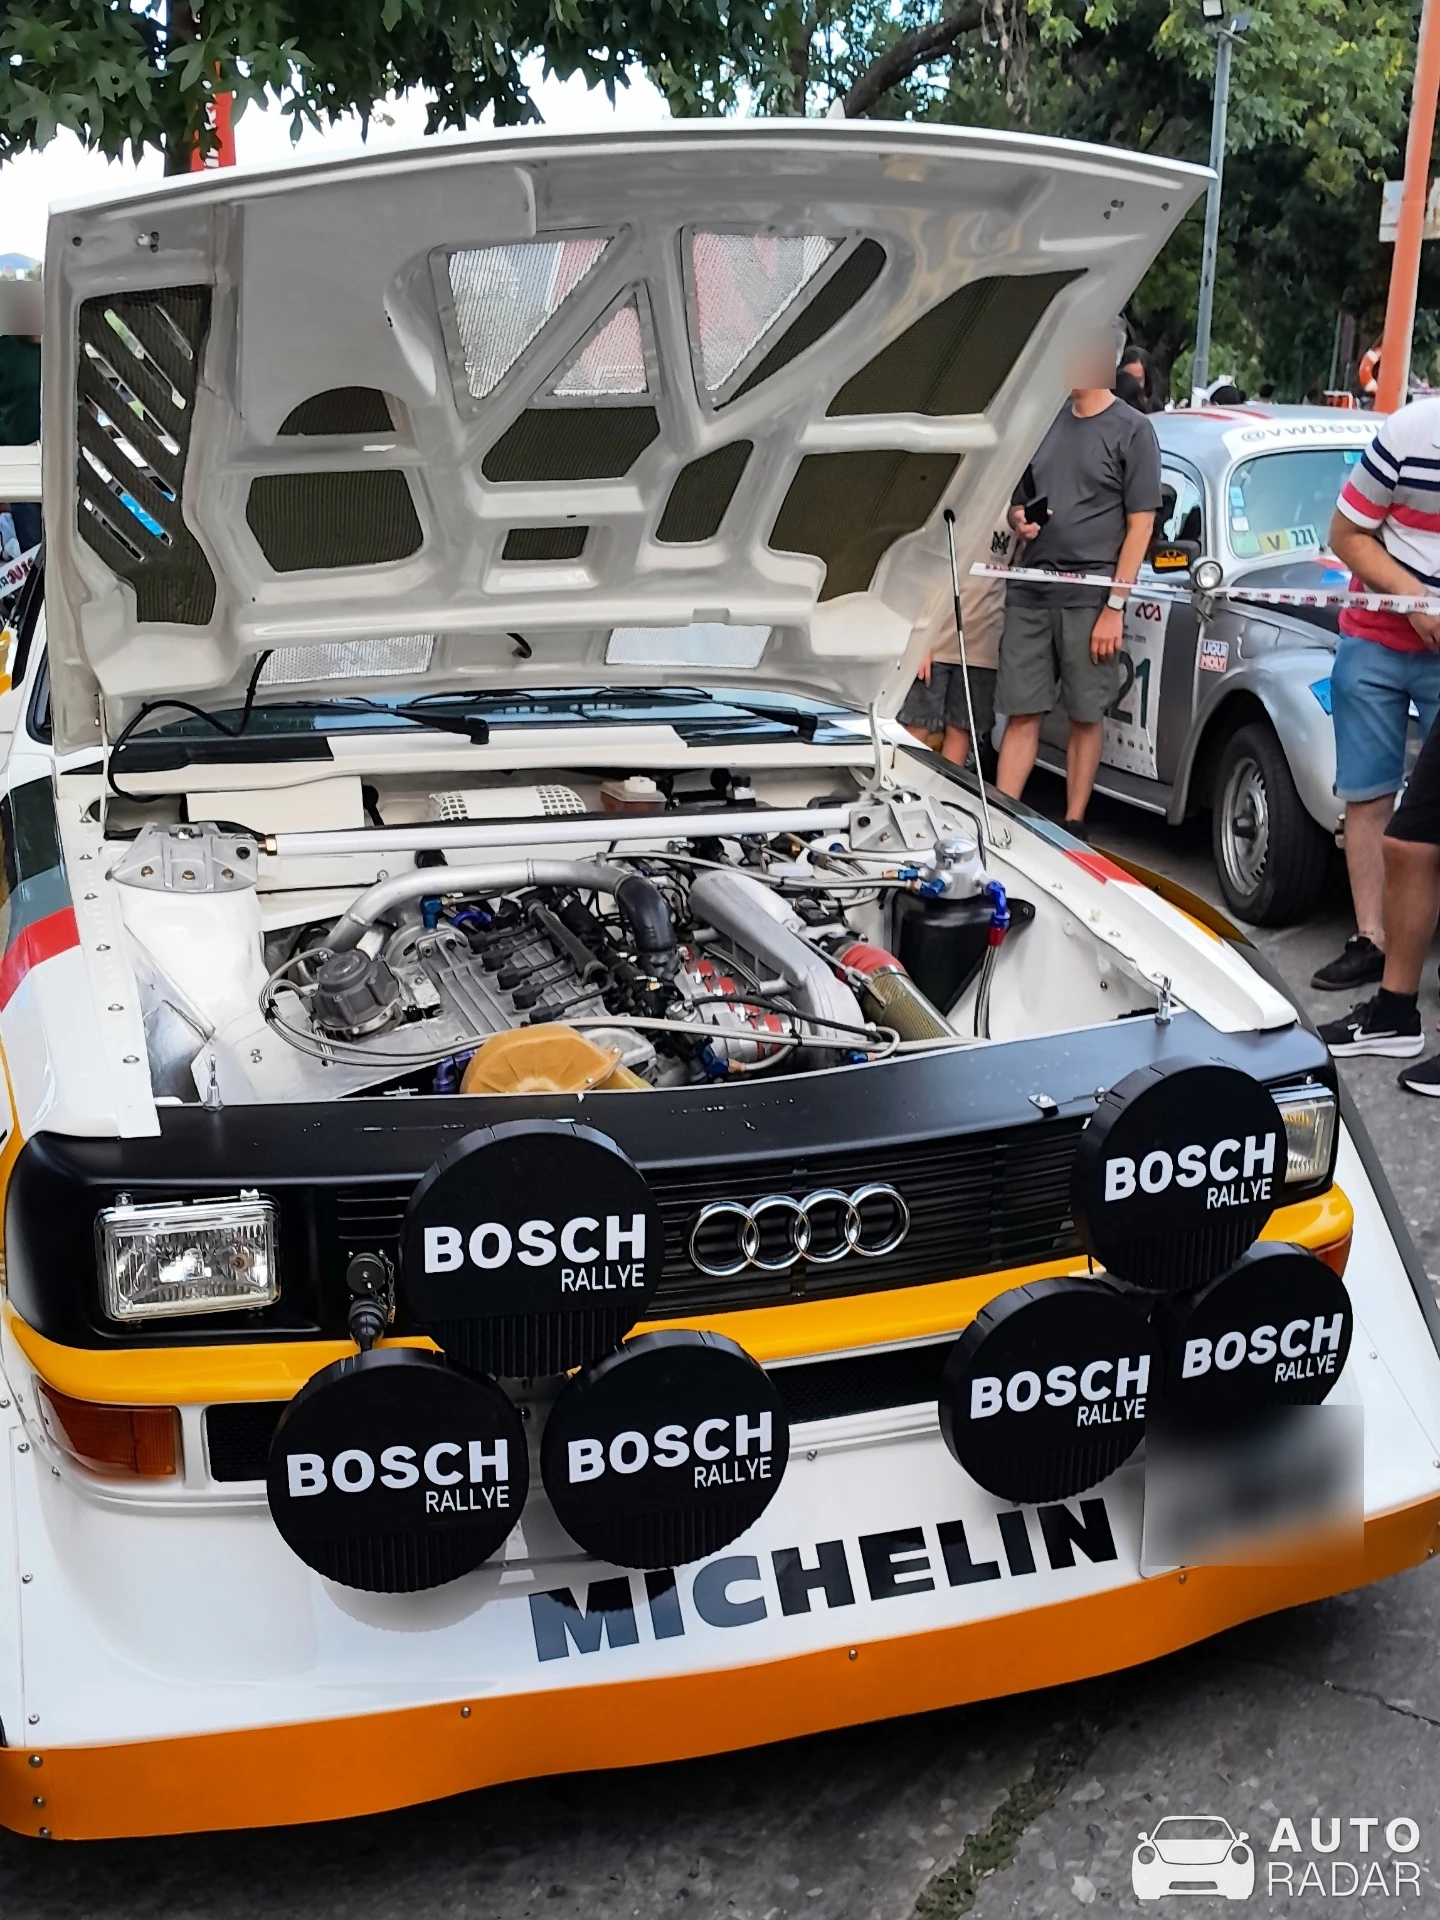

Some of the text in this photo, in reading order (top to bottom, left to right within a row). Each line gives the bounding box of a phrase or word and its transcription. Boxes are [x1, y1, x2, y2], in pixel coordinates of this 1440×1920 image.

[1103, 650, 1151, 729] 21
[1105, 1133, 1275, 1201] BOSCH
[1206, 1178, 1273, 1210] RALLYE
[424, 1213, 646, 1274] BOSCH
[561, 1263, 645, 1293] RALLYE
[1182, 1313, 1343, 1379] BOSCH
[1274, 1353, 1337, 1383] RALLYE
[970, 1354, 1151, 1420] BOSCH
[1077, 1397, 1147, 1427] RALLYE
[286, 1438, 509, 1497] BOSCH
[567, 1411, 772, 1484] BOSCH
[694, 1456, 772, 1489] RALLYE
[425, 1485, 510, 1514] RALLYE
[528, 1498, 1118, 1662] MICHELIN
